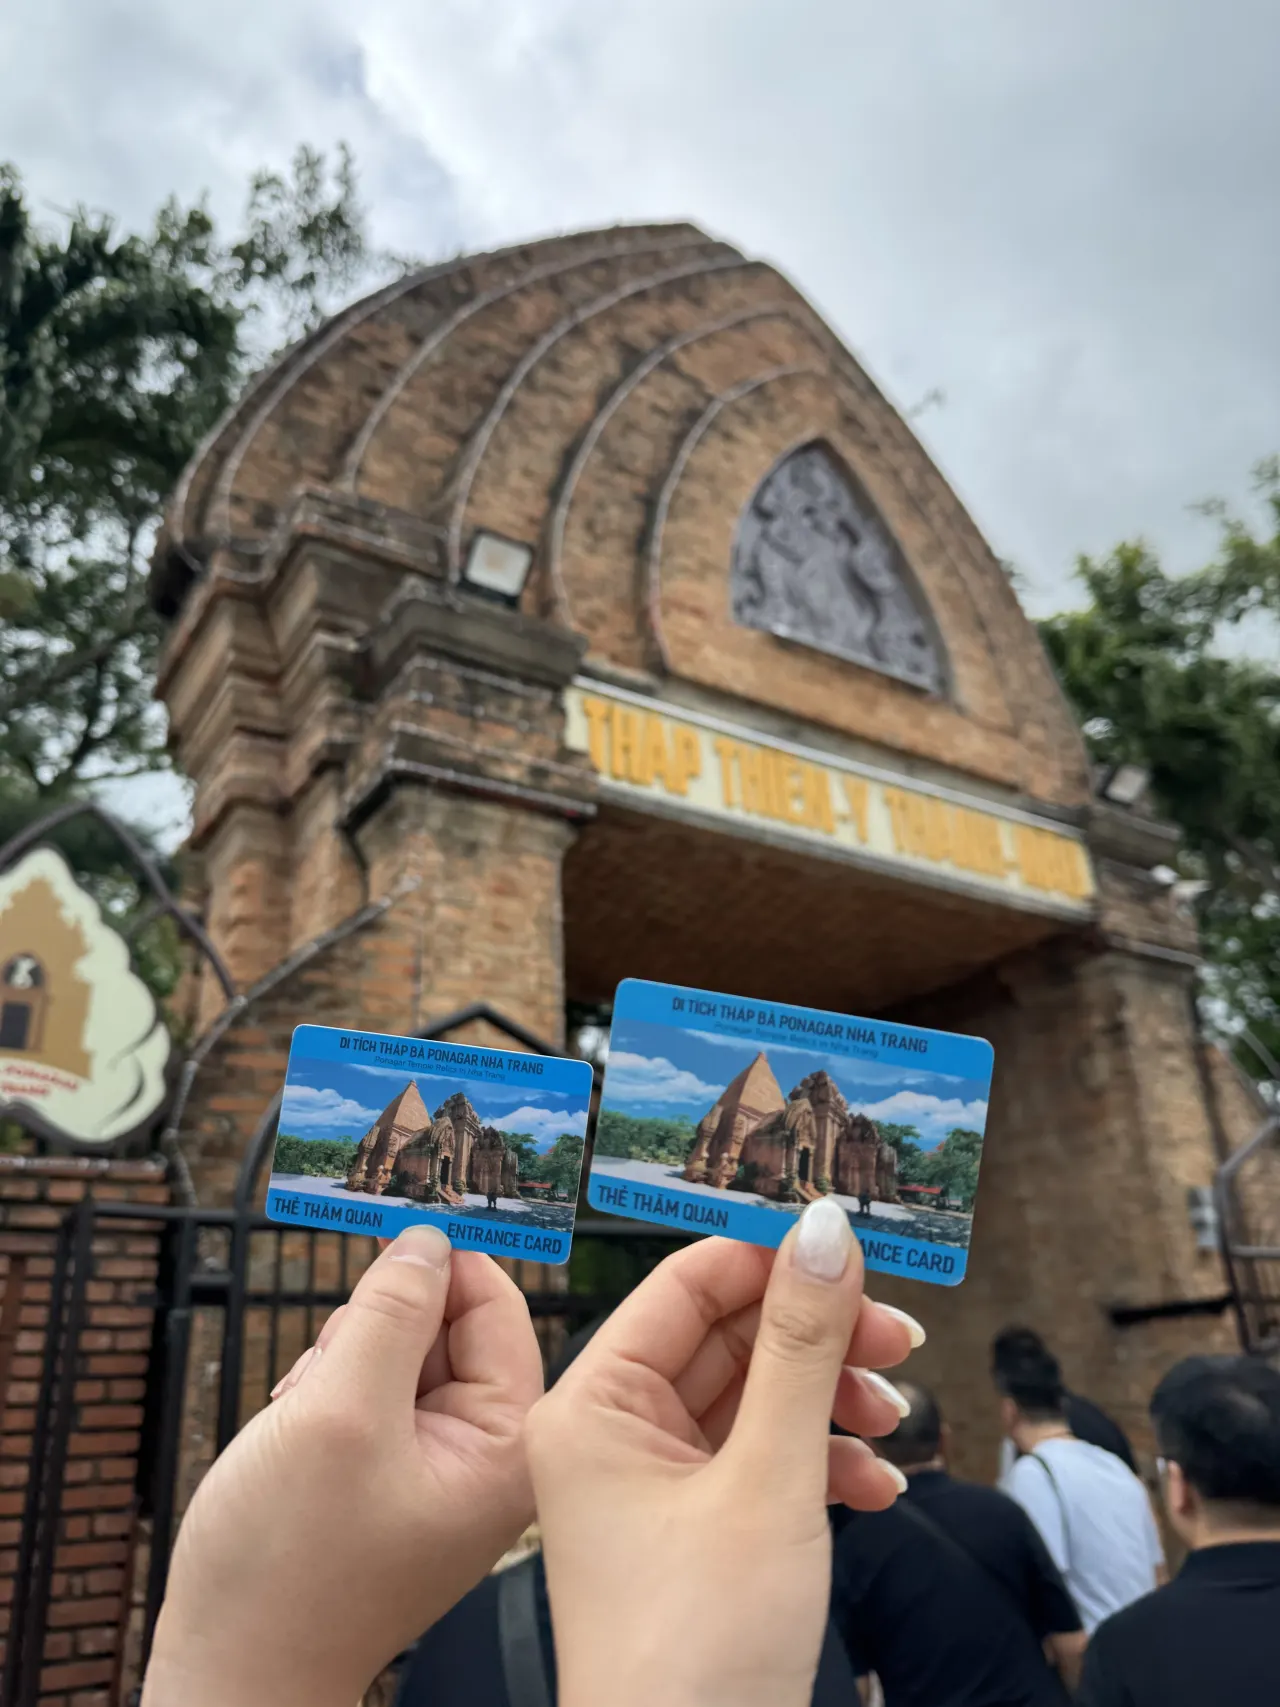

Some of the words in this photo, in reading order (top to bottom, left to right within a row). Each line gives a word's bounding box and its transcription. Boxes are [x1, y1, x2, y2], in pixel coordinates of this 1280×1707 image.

[672, 996, 684, 1011] DI
[720, 1003, 755, 1022] THÁP
[778, 1014, 844, 1040] PONAGAR
[846, 1025, 876, 1045] NHA
[880, 1031, 928, 1053] TRANG
[339, 1037, 351, 1049] DI
[353, 1036, 377, 1052] TÍCH
[379, 1041, 409, 1056] THÁP
[410, 1044, 425, 1059] BÀ
[427, 1047, 479, 1067] PONAGAR
[480, 1055, 504, 1070] NHA
[507, 1058, 544, 1075] TRANG
[274, 1196, 301, 1216] THẺ
[303, 1201, 343, 1222] THĂM
[345, 1208, 383, 1228] QUAN
[597, 1184, 629, 1208] THẺ
[633, 1192, 680, 1218] THĂM
[683, 1202, 728, 1229] QUAN
[446, 1222, 522, 1249] ENTRANCE
[524, 1234, 562, 1255] CARD
[859, 1237, 904, 1264] ANCE
[906, 1247, 955, 1274] CARD
